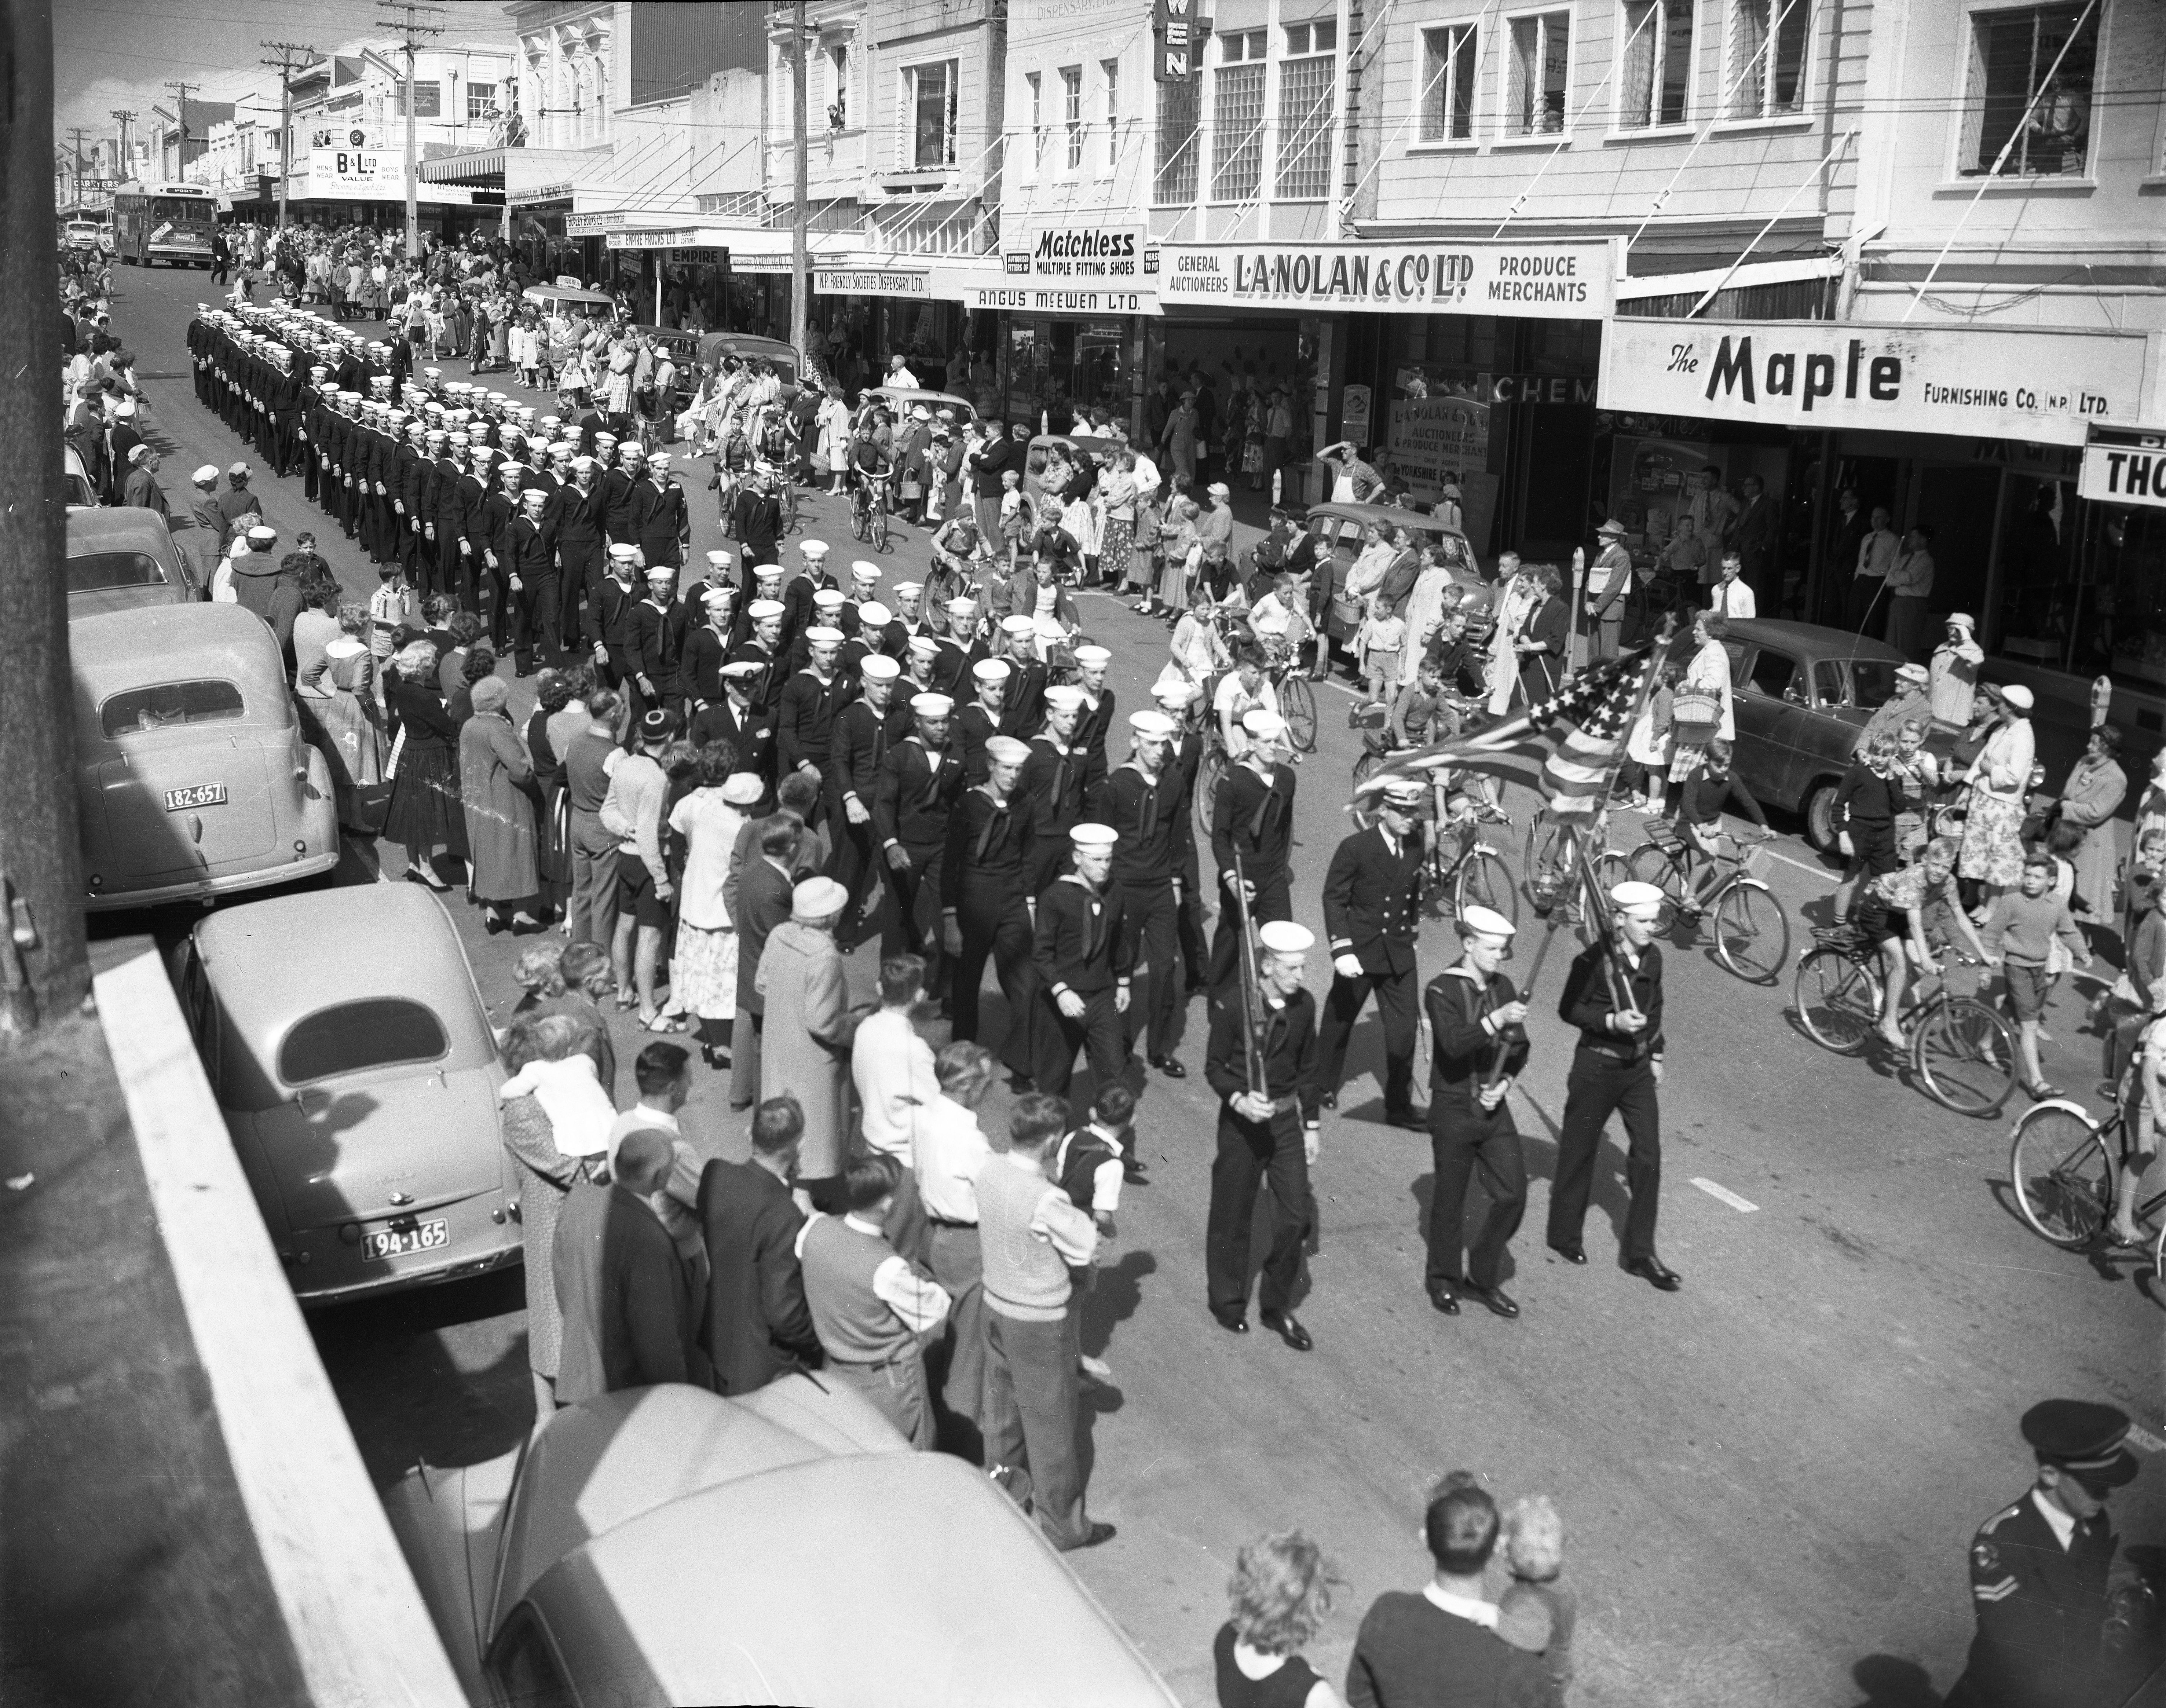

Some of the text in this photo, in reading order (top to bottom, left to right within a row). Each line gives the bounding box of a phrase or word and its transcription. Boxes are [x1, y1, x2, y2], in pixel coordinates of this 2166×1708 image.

[337, 153, 348, 173] B
[350, 158, 355, 166] &
[568, 216, 582, 226] BURLEY
[583, 215, 596, 226] BOOKS
[626, 231, 677, 246] EMPIRE FROCKS LTD.
[1035, 230, 1134, 259] Matchless
[672, 249, 718, 263] EMPIRE
[1008, 255, 1029, 263] AUTHORISED
[1178, 256, 1220, 272] GENERAL
[1008, 263, 1029, 272] FITTERS OF
[1036, 261, 1135, 276] MULTIPLE FITTING SHOES
[1145, 262, 1151, 271] TO
[1499, 257, 1576, 276] PRODUCE
[820, 272, 924, 292] N.P. FRIENDLY SOCIETIES DISPENSARY LTD.
[1170, 276, 1228, 292] AUCTIONEERS
[1374, 259, 1391, 299] &
[1489, 281, 1587, 301] MERCHANTS
[979, 290, 1026, 306] ANGUS
[1109, 294, 1140, 310] LTD.
[1667, 344, 1698, 373] The
[1705, 336, 1901, 411] Maple
[1924, 383, 2008, 407] FURNISHING
[1493, 377, 1598, 404] CHEM
[1412, 427, 1474, 443] AUCTIONEERS
[1402, 439, 1439, 452] PRODUCE
[1401, 464, 1437, 480] YORKSHIRE
